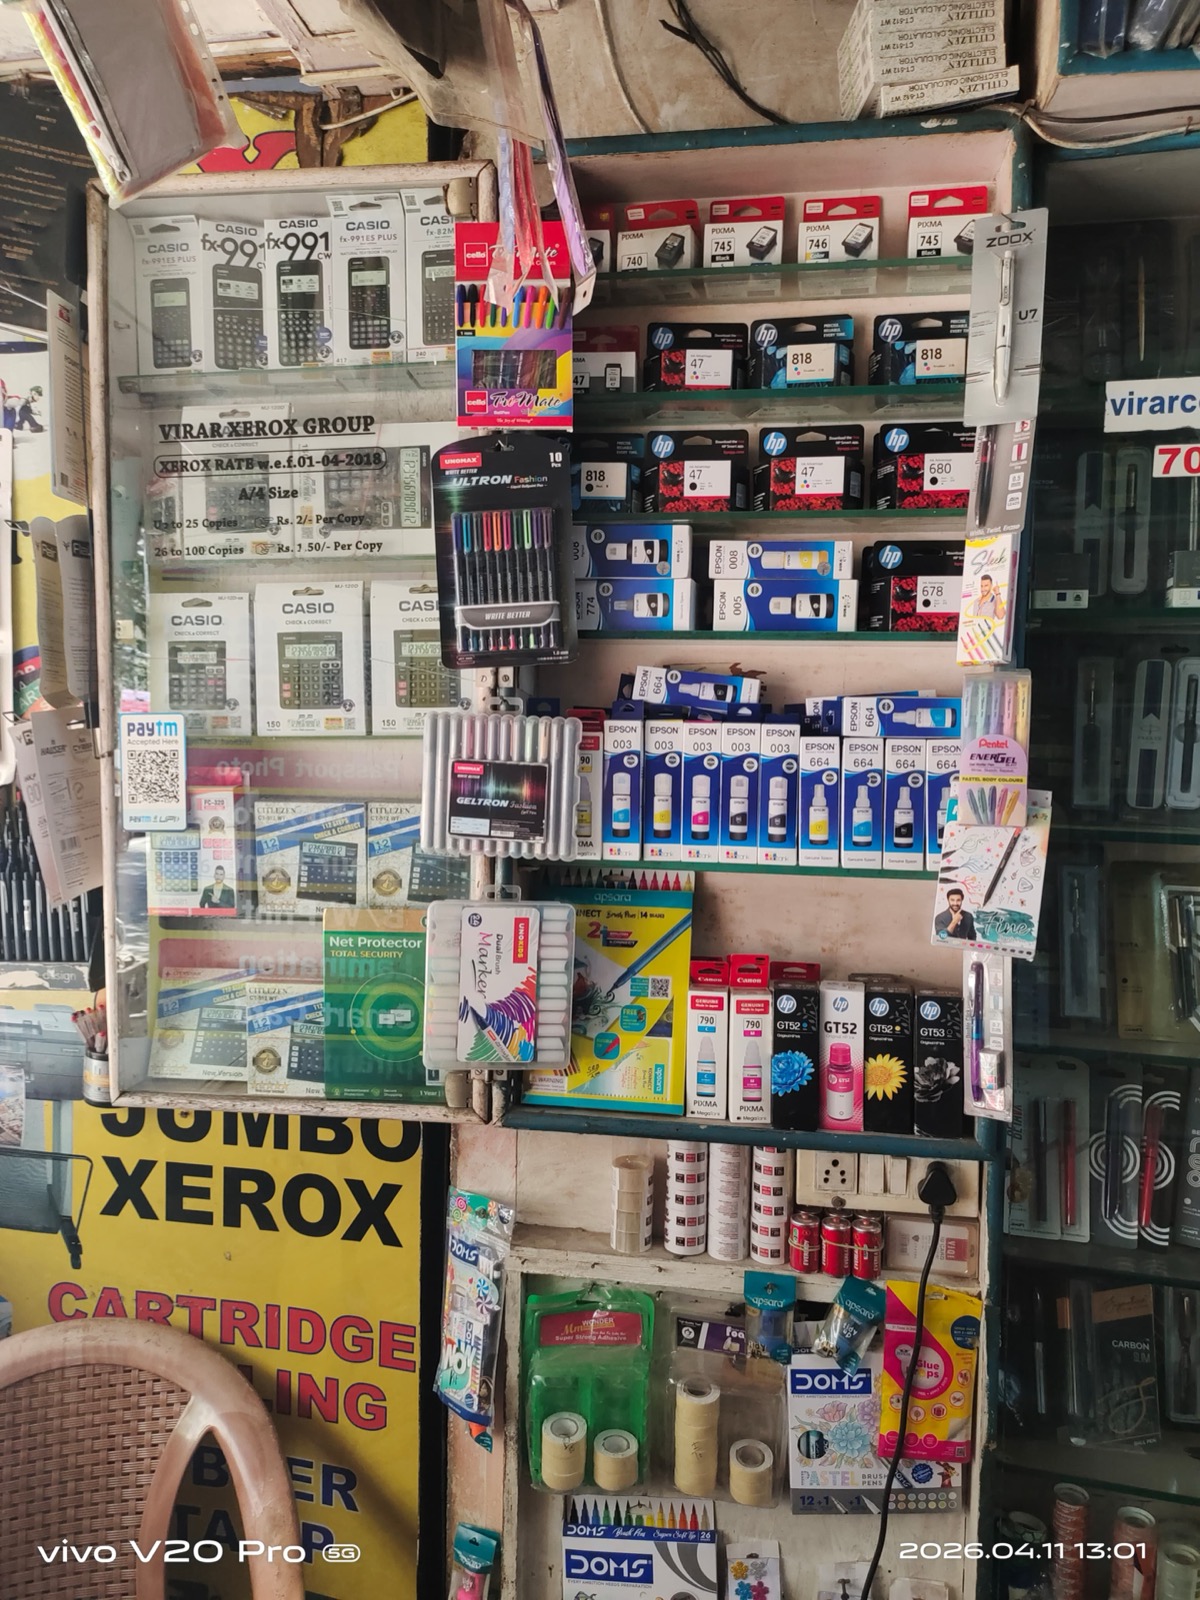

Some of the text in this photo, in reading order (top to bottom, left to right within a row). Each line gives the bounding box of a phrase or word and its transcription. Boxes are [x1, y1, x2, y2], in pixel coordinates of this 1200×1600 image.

[899, 1, 995, 15] ELECTRONIC CALCULATOR
[279, 219, 319, 229] CASIO
[346, 220, 390, 231] CASIO
[806, 224, 830, 233] PIXMA
[917, 221, 943, 229] PIXMA
[216, 224, 258, 237] CASIO
[621, 233, 644, 241] PIXMA
[920, 235, 939, 246] 745
[986, 231, 1033, 248] ZOOX
[147, 242, 189, 254] CASIO
[266, 232, 330, 261] fx-991
[714, 240, 732, 253] 745
[808, 238, 828, 250] 746
[317, 252, 332, 260] CW
[466, 251, 486, 259] cello
[626, 255, 643, 268] 740
[1018, 309, 1038, 321] U7
[792, 353, 812, 364] 818
[921, 348, 943, 360] 818
[690, 358, 704, 369] 47
[159, 415, 375, 440] VIRAR XEROX GROUP
[763, 432, 787, 456] hp
[885, 428, 910, 452] hp
[652, 435, 674, 458] hp
[549, 452, 562, 462] 10
[1158, 446, 1200, 475] 70
[159, 459, 211, 473] XEROX
[215, 457, 254, 471] RATE
[929, 463, 952, 475] 680
[586, 470, 606, 482] 818
[689, 470, 702, 480] 47
[801, 466, 815, 478] 47
[452, 475, 512, 486] ULTRON
[514, 475, 548, 483] Fashion
[238, 487, 298, 500] A/4 Size
[171, 520, 183, 529] to
[185, 519, 199, 528] 25
[202, 517, 238, 530] Copies
[277, 516, 293, 526] Rs.
[296, 515, 313, 526] 2/-
[316, 515, 336, 525] Per
[337, 514, 365, 527] Copy
[154, 547, 168, 557] 26
[170, 547, 182, 557] to
[185, 545, 205, 556] 100
[208, 545, 244, 558] Copies
[277, 544, 294, 553] Rs.
[334, 541, 353, 551] Per
[355, 540, 383, 554] Copy
[729, 550, 738, 569] 008
[921, 585, 944, 597] 678
[282, 602, 335, 614] CASIO
[586, 597, 596, 615] 774
[734, 596, 742, 615] 005
[171, 615, 222, 626] CASIO
[485, 611, 531, 621] WRITE BETTER
[639, 669, 649, 697] EPSON
[653, 676, 663, 694] 664
[850, 702, 858, 732] EPSON
[865, 707, 874, 727] 664
[267, 720, 280, 728] 150
[650, 727, 679, 735] EPSON
[766, 729, 795, 737] EPSON
[613, 740, 632, 749] 003
[654, 741, 674, 750] 003
[693, 742, 712, 751] 003
[731, 743, 751, 751] 003
[770, 744, 790, 753] 003
[805, 743, 835, 751] EPSON
[849, 744, 879, 752] EPSON
[891, 745, 921, 753] EPSON
[979, 738, 1008, 748] Pentel
[810, 758, 830, 767] 664
[854, 759, 874, 767] 664
[895, 760, 915, 769] 664
[937, 760, 957, 769] 664
[456, 797, 509, 807] GELTRON
[594, 893, 631, 903] apsara
[982, 911, 1030, 935] Fine
[329, 936, 422, 949] Net Protector
[330, 950, 358, 958] TOTAL
[477, 932, 493, 999] Marker
[777, 995, 797, 1013] hp
[833, 996, 849, 1013] hp
[869, 997, 889, 1017] hp
[920, 1001, 941, 1020] hp
[700, 1016, 715, 1025] 790
[746, 1020, 761, 1029] 790
[777, 1021, 800, 1030] GT52
[824, 1021, 857, 1035] GT52
[869, 1024, 893, 1033] GT52
[920, 1028, 945, 1037] GT53
[693, 1099, 718, 1108] PIXMA
[739, 1105, 764, 1113] PIXMA
[99, 1155, 404, 1248] XEROX
[751, 1297, 784, 1308] apsara
[844, 1297, 875, 1320] apsara
[1112, 1339, 1150, 1350] CARBON
[795, 1374, 867, 1390] DOMS
[801, 1471, 858, 1486] PASTEL
[570, 1555, 648, 1578] DOMS
